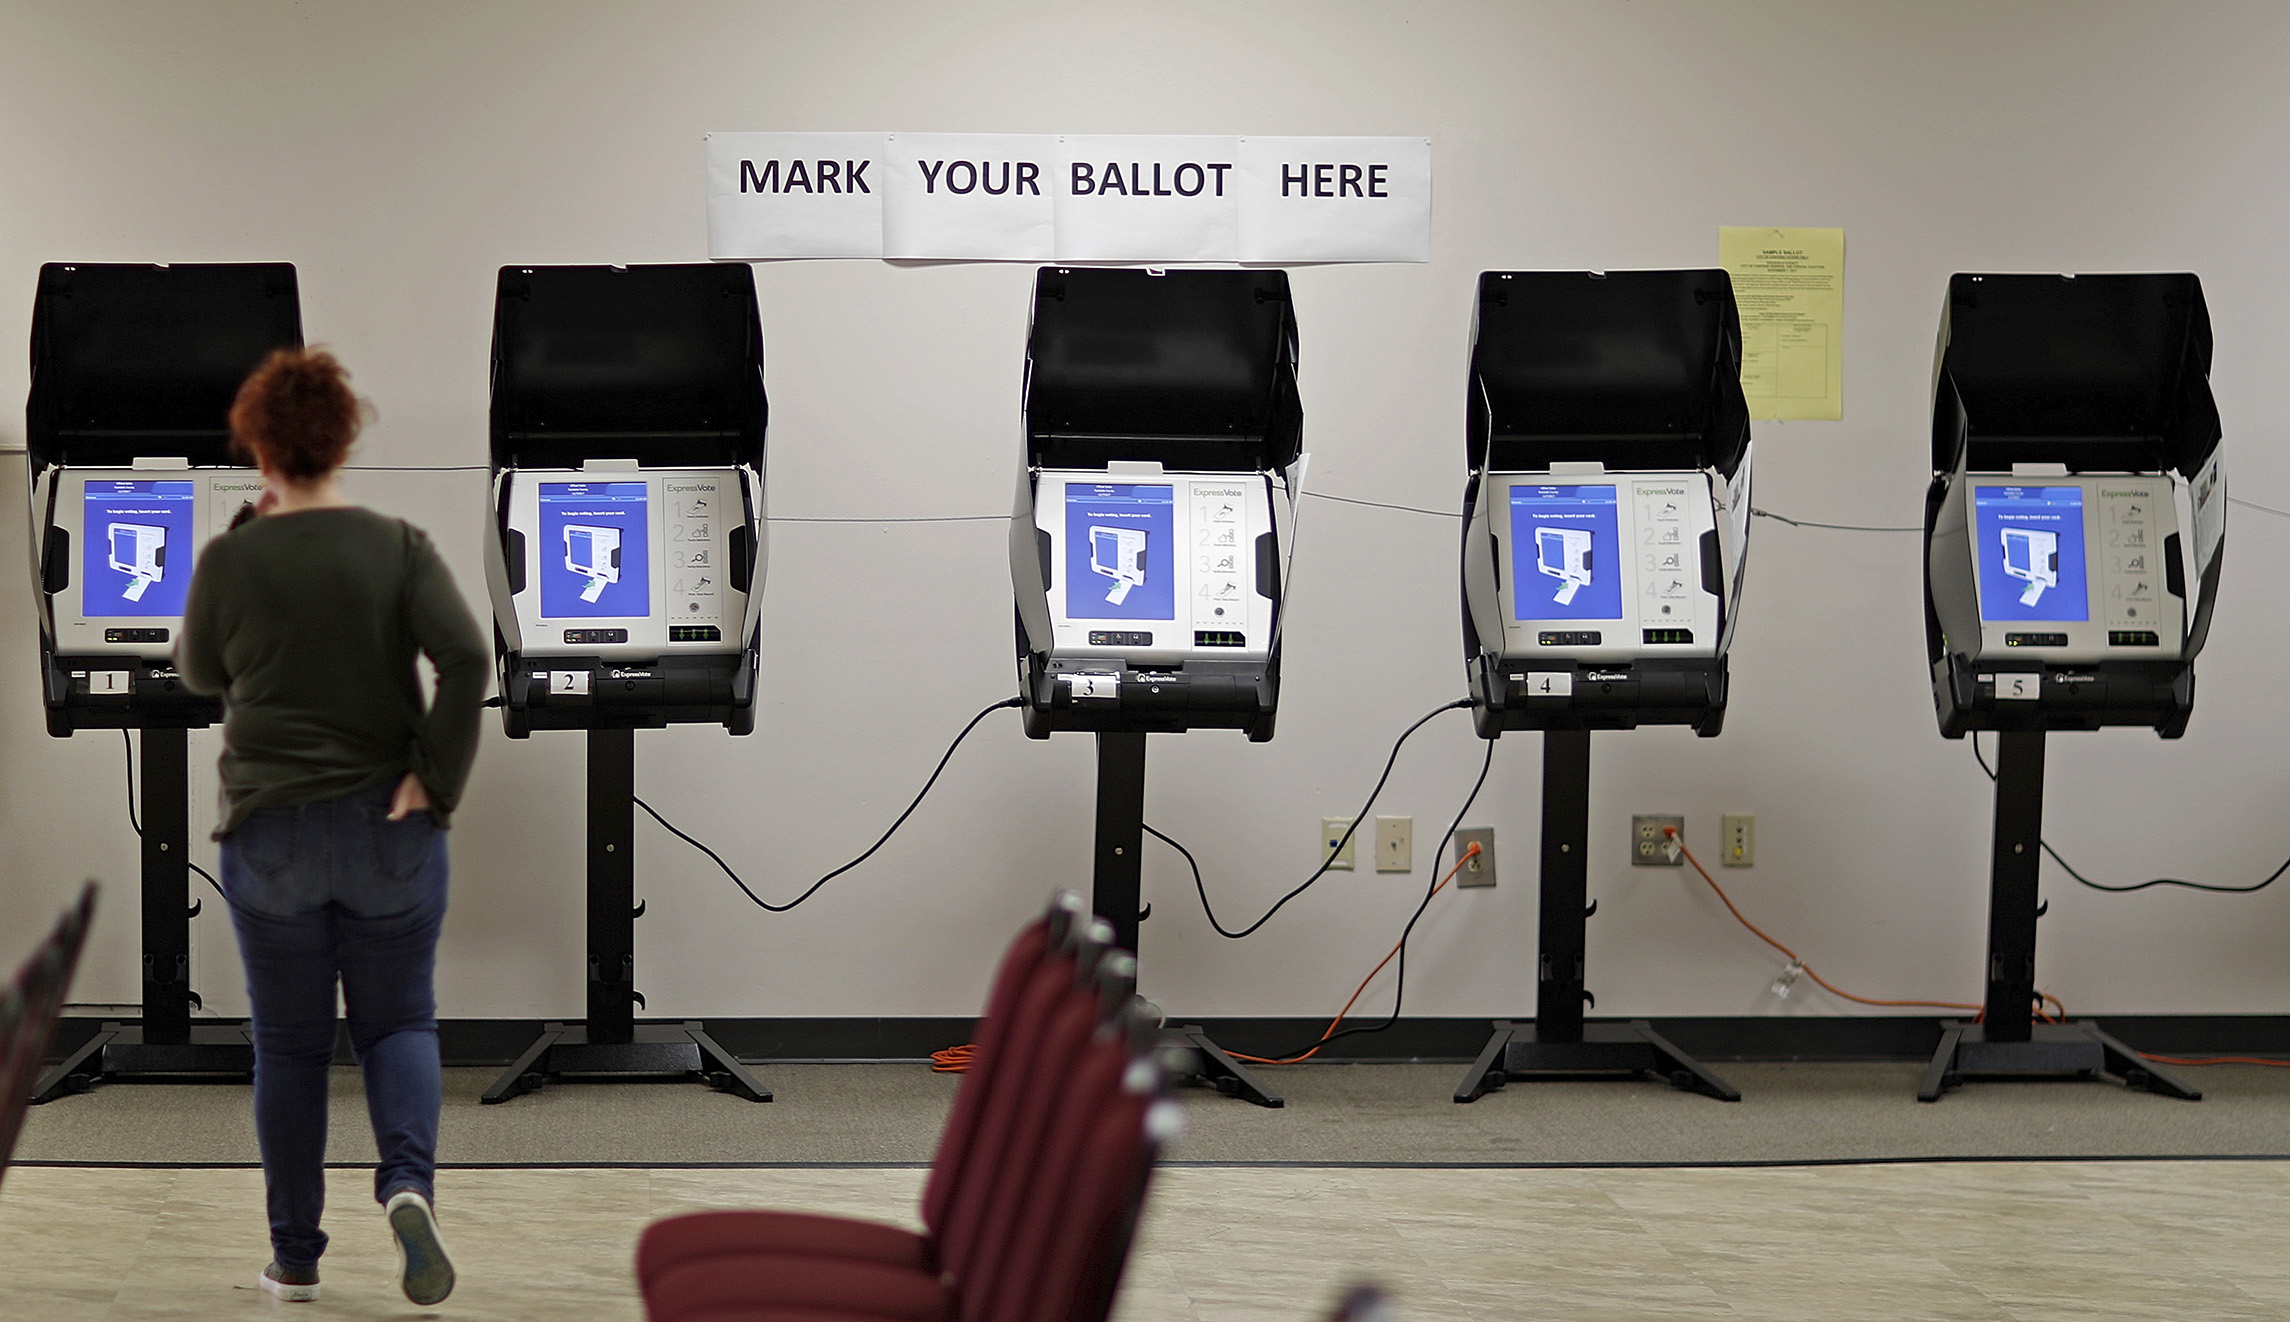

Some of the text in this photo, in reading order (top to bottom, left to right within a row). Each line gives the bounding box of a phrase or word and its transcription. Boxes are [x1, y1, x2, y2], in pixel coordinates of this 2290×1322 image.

[740, 159, 1388, 198] MARK YOUR BALLOT HERE
[667, 484, 715, 493] ExpressVote
[1193, 488, 1242, 497] ExpressVote
[1637, 488, 1684, 496] ExpressVote
[673, 501, 680, 518] 1
[1200, 505, 1206, 522] 1
[673, 524, 684, 542] 2
[1199, 528, 1210, 546] 2
[673, 550, 685, 569] 3
[1200, 555, 1210, 573] 3
[672, 578, 685, 596] 4
[1198, 583, 1211, 601] 4
[105, 673, 114, 689] 1
[563, 673, 574, 690] 2
[1539, 676, 1551, 693] 4
[1596, 673, 1627, 681] ExpressVote
[1082, 678, 1094, 696] 3
[2012, 680, 2024, 696] 5
